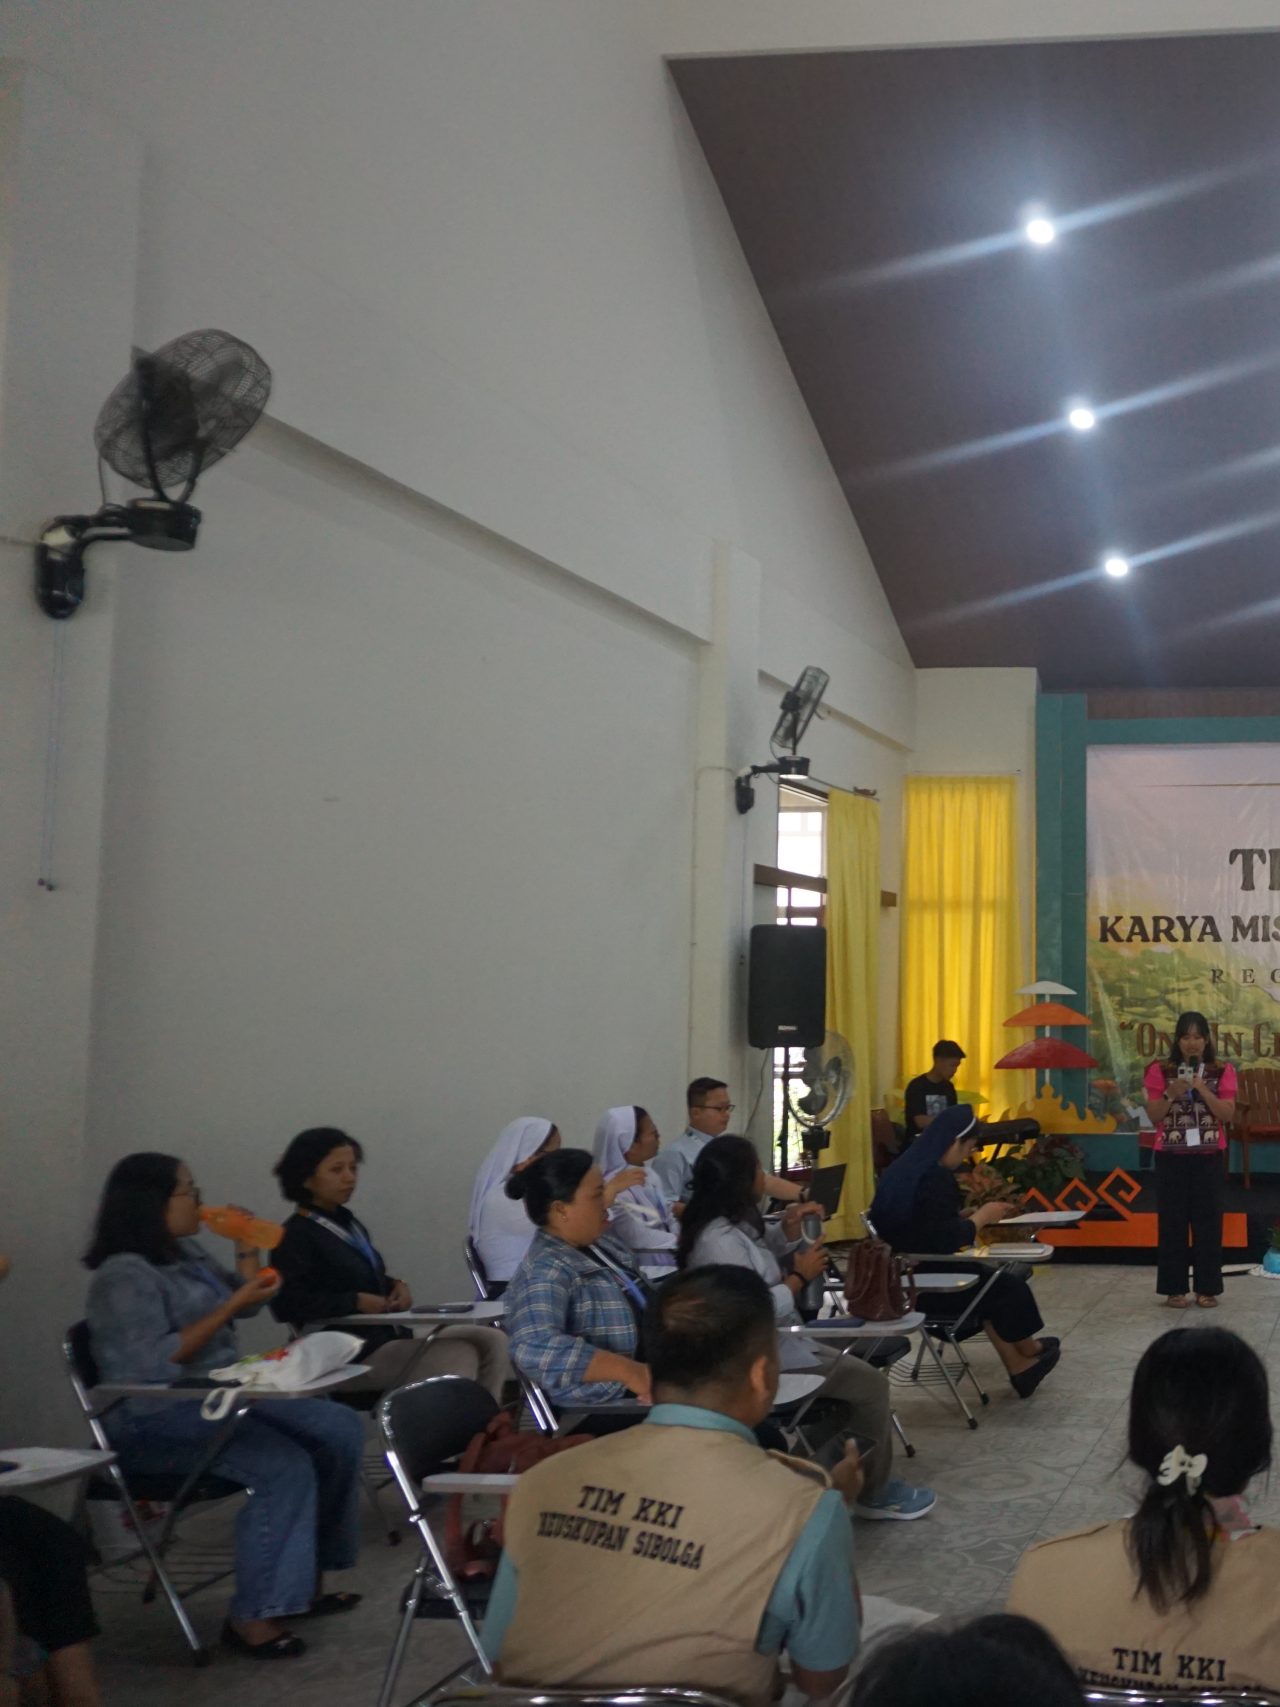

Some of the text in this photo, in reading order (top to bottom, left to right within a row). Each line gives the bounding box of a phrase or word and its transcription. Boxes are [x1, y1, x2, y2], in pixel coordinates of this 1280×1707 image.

[1099, 915, 1222, 943] KARYA
[577, 1485, 686, 1530] TIM KKI
[632, 1530, 706, 1571] SIBOLGA
[1112, 1648, 1163, 1677] TIM
[1177, 1654, 1227, 1682] KKI
